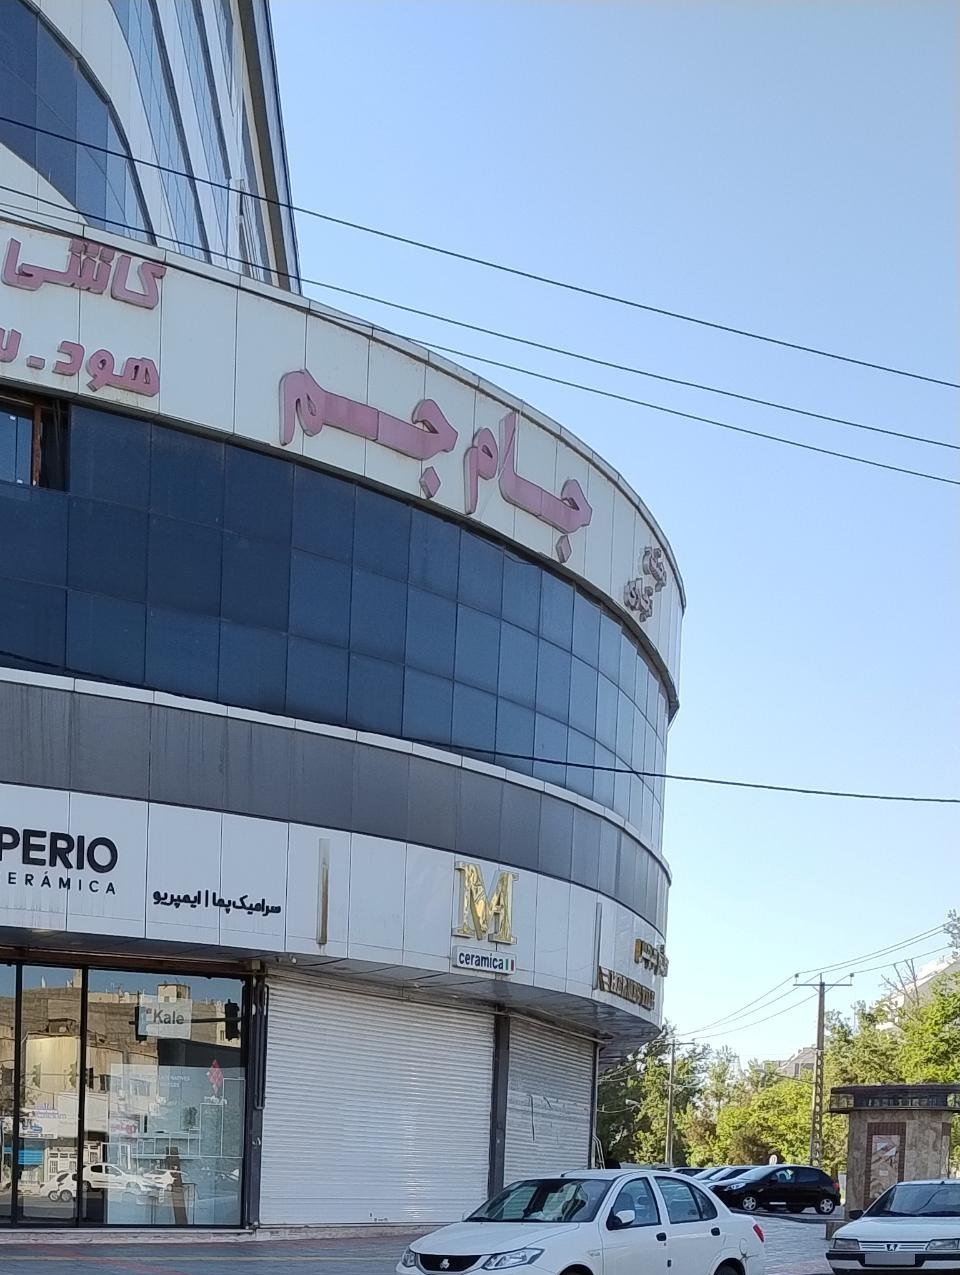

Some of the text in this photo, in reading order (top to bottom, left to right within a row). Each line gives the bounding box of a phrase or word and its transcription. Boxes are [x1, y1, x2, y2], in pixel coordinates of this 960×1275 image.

[1, 237, 167, 310] کاشی
[52, 340, 161, 398] هود
[279, 369, 593, 564] جام جم
[152, 890, 202, 909] ایمپریو
[232, 895, 282, 917] سرامیک
[458, 950, 505, 970] ceramica
[153, 1009, 185, 1025] Kale
